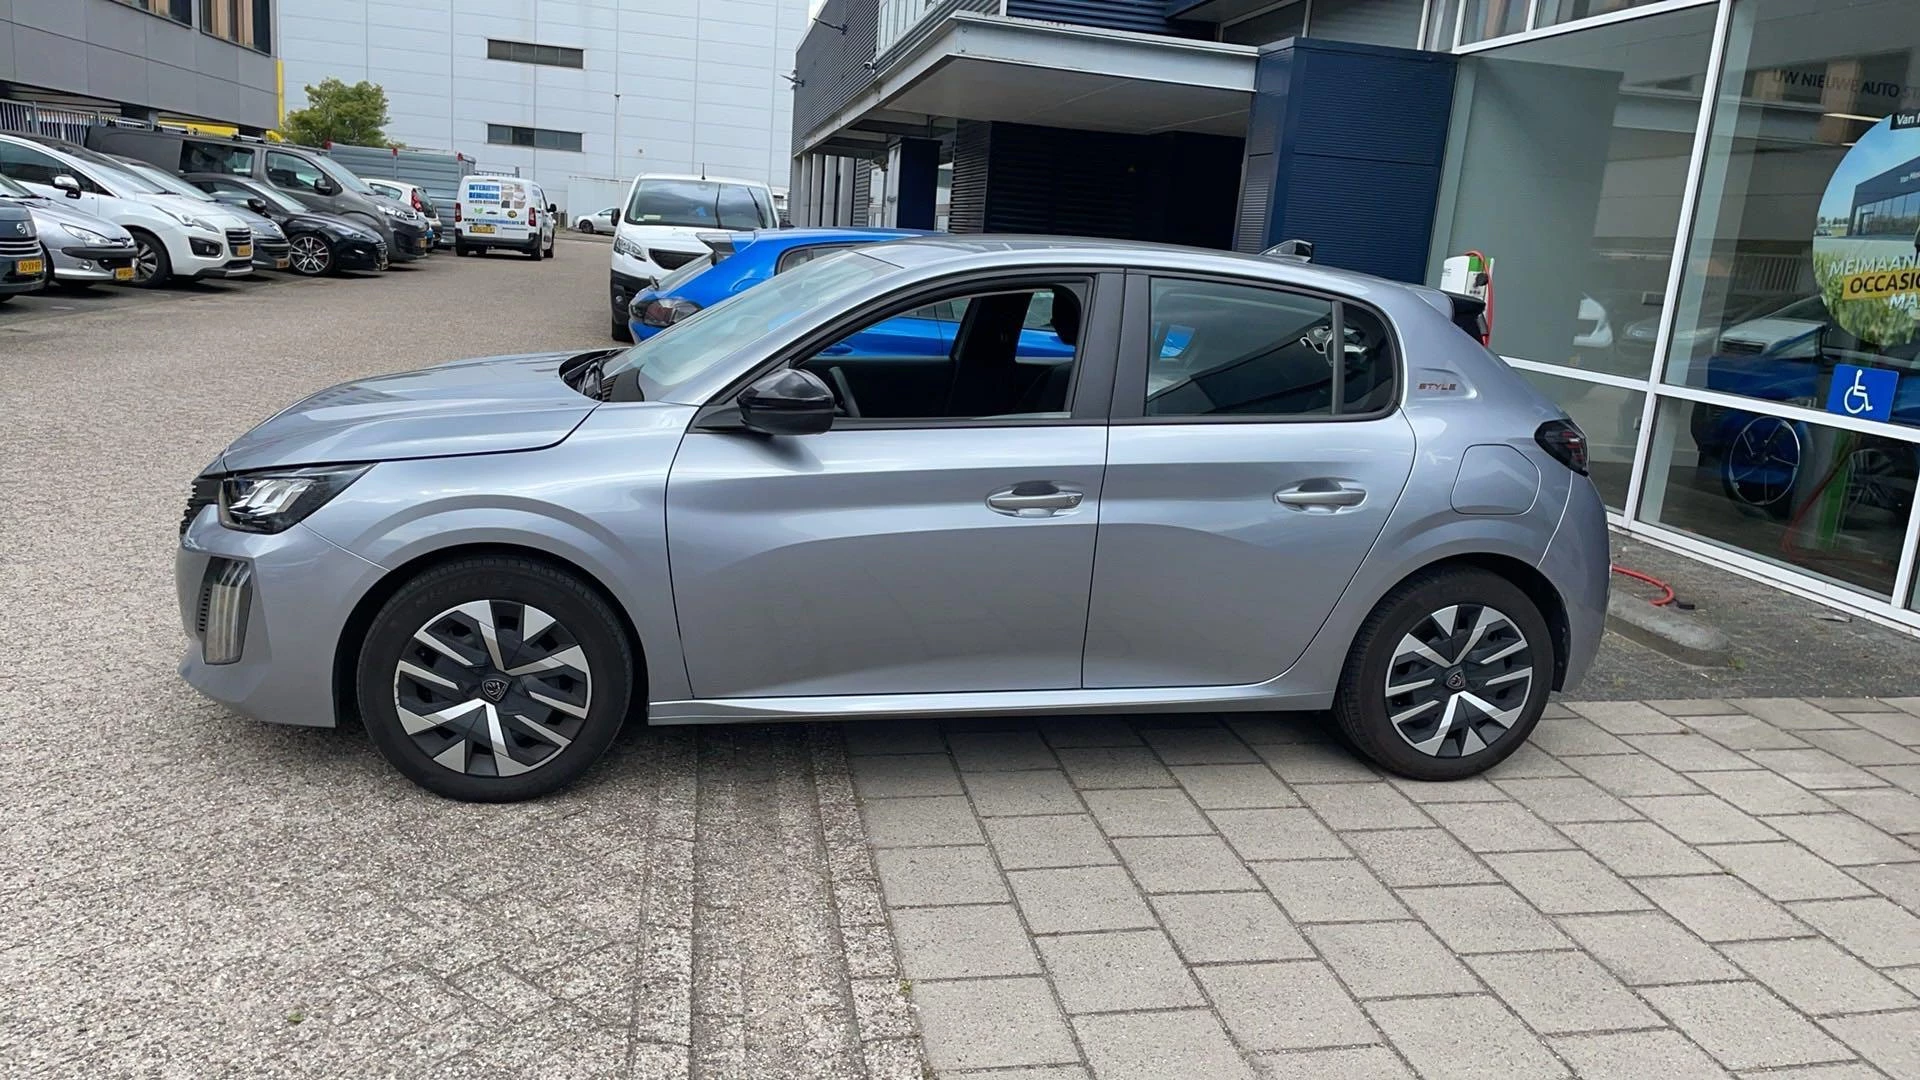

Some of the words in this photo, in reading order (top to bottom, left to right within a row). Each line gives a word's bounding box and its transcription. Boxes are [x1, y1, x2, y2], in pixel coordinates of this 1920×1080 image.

[1774, 69, 1799, 85] UW
[1801, 73, 1858, 92] NIEUWE
[1861, 80, 1900, 98] AUTO
[1896, 113, 1915, 126] Van
[1889, 291, 1920, 310] MA
[1418, 383, 1457, 391] STYLE
